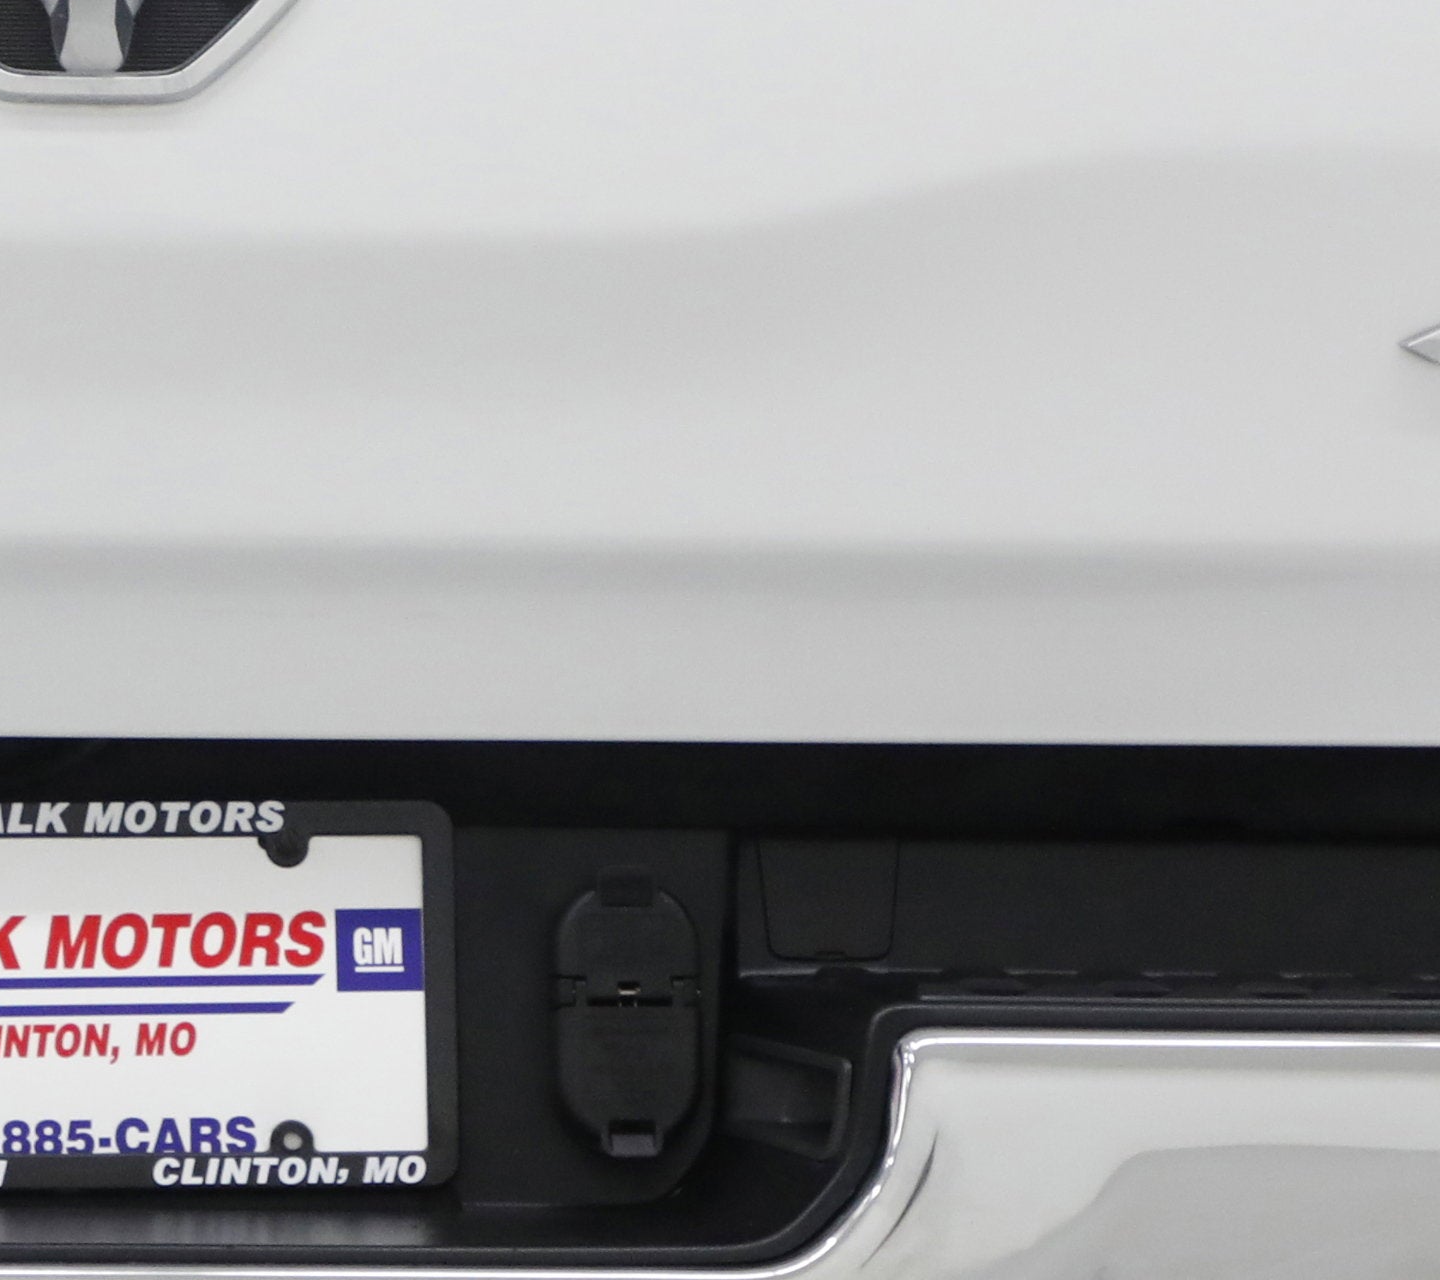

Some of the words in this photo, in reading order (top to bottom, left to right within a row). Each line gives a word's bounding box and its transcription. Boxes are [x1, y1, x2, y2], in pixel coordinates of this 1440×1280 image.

[83, 800, 285, 834] MOTORS
[44, 910, 325, 969] MOTORS
[352, 928, 403, 965] GM
[135, 1022, 197, 1057] MO
[152, 1157, 350, 1186] CLINTON,
[362, 1157, 427, 1185] MO
